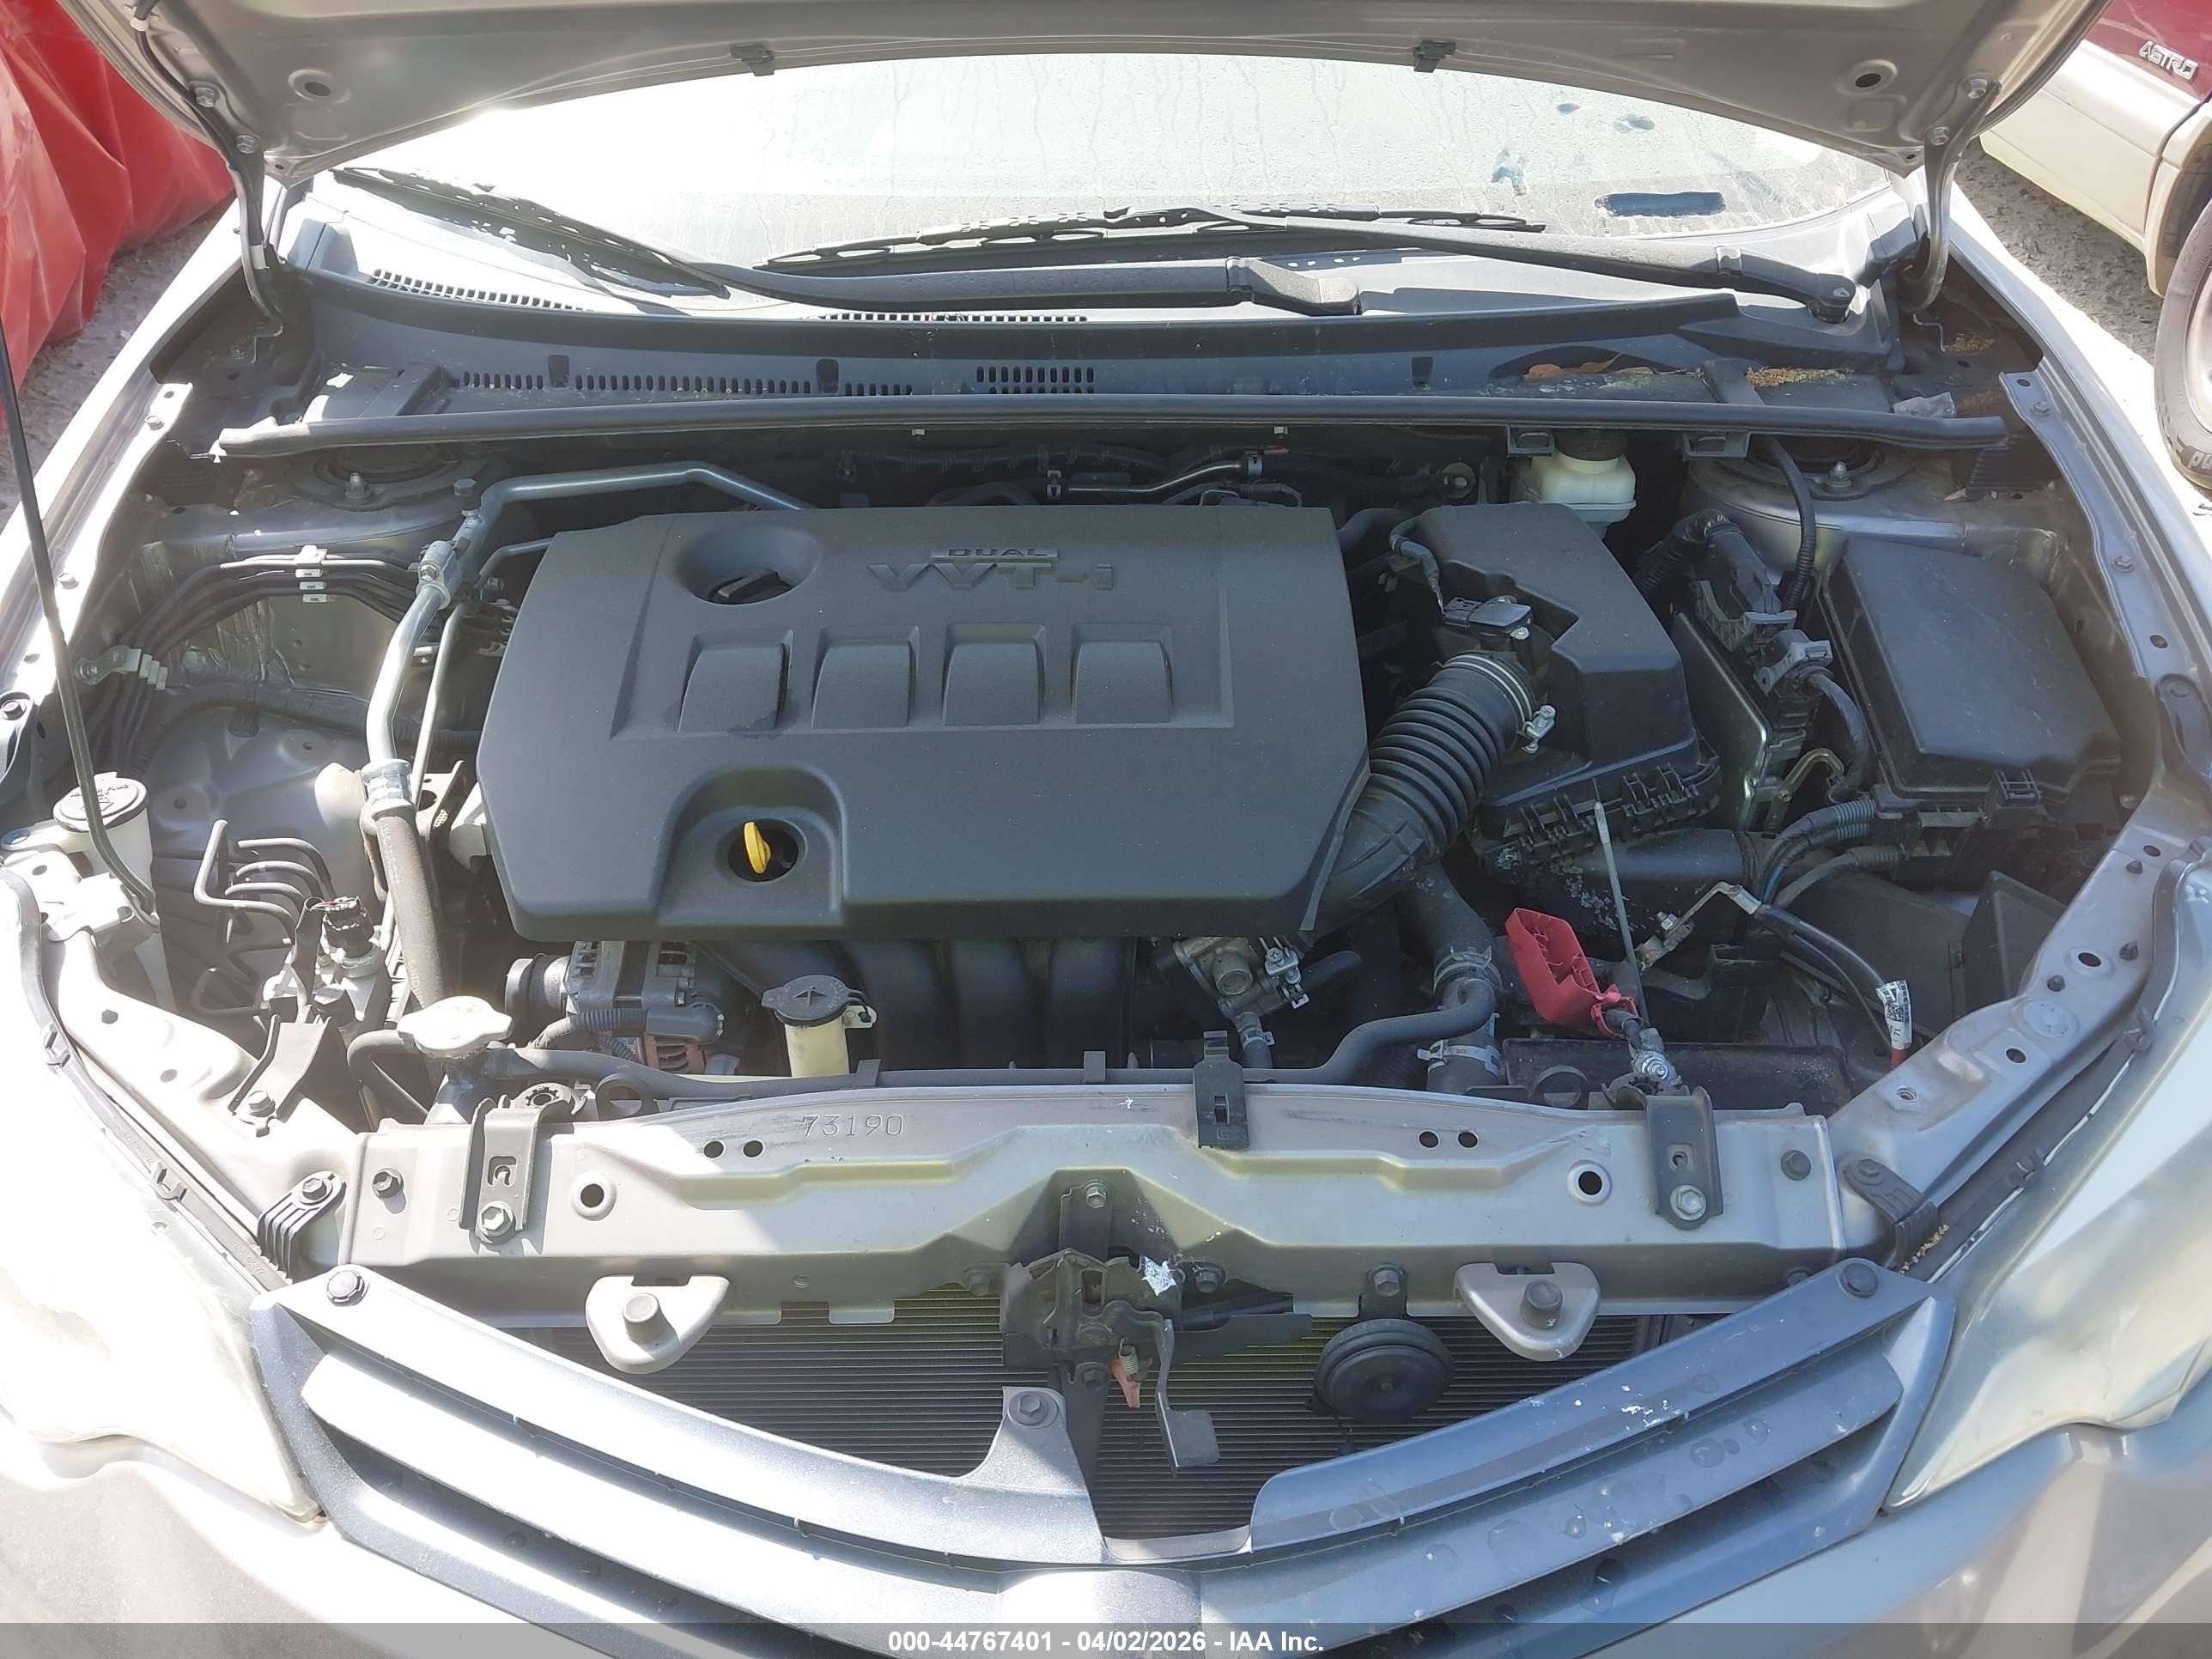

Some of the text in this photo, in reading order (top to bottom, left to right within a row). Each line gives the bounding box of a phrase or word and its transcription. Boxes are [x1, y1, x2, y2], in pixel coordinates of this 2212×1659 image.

[2139, 40, 2199, 81] ASTRO
[947, 548, 1048, 557] DUAL
[801, 1114, 905, 1138] 73190
